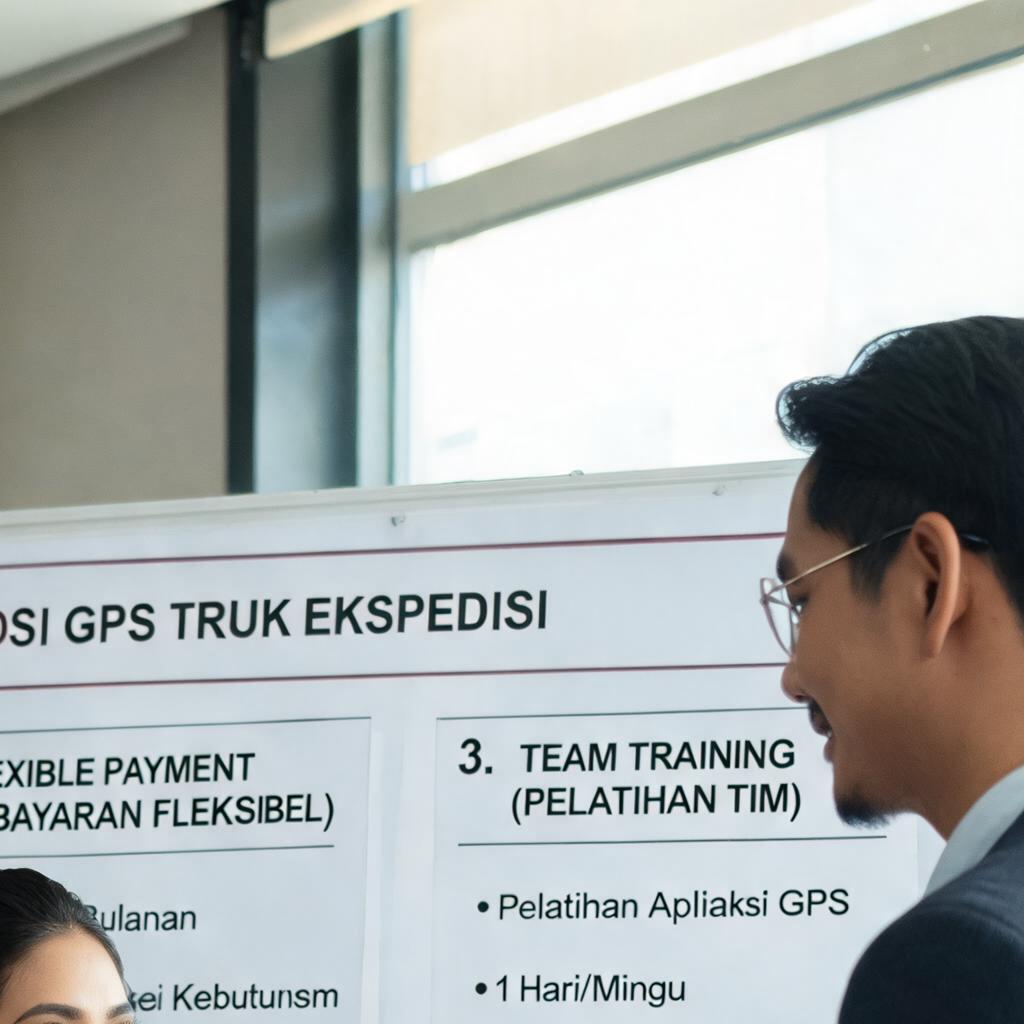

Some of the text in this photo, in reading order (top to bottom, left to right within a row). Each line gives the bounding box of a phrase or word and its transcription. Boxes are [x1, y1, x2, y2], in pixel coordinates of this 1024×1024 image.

[64, 602, 156, 645] GPS
[169, 598, 292, 643] TRUK
[303, 589, 548, 637] EKSPEDISI
[103, 752, 257, 787] PAYMENT
[457, 737, 796, 776] 3. TEAM TRAINING
[152, 792, 336, 833] FLEKSIBEL)
[510, 782, 802, 826] (PELATIHAN TIM)
[497, 887, 851, 926] Pelatihan Apliaksi GPS
[495, 972, 687, 1009] 1 Hari/Mingu
